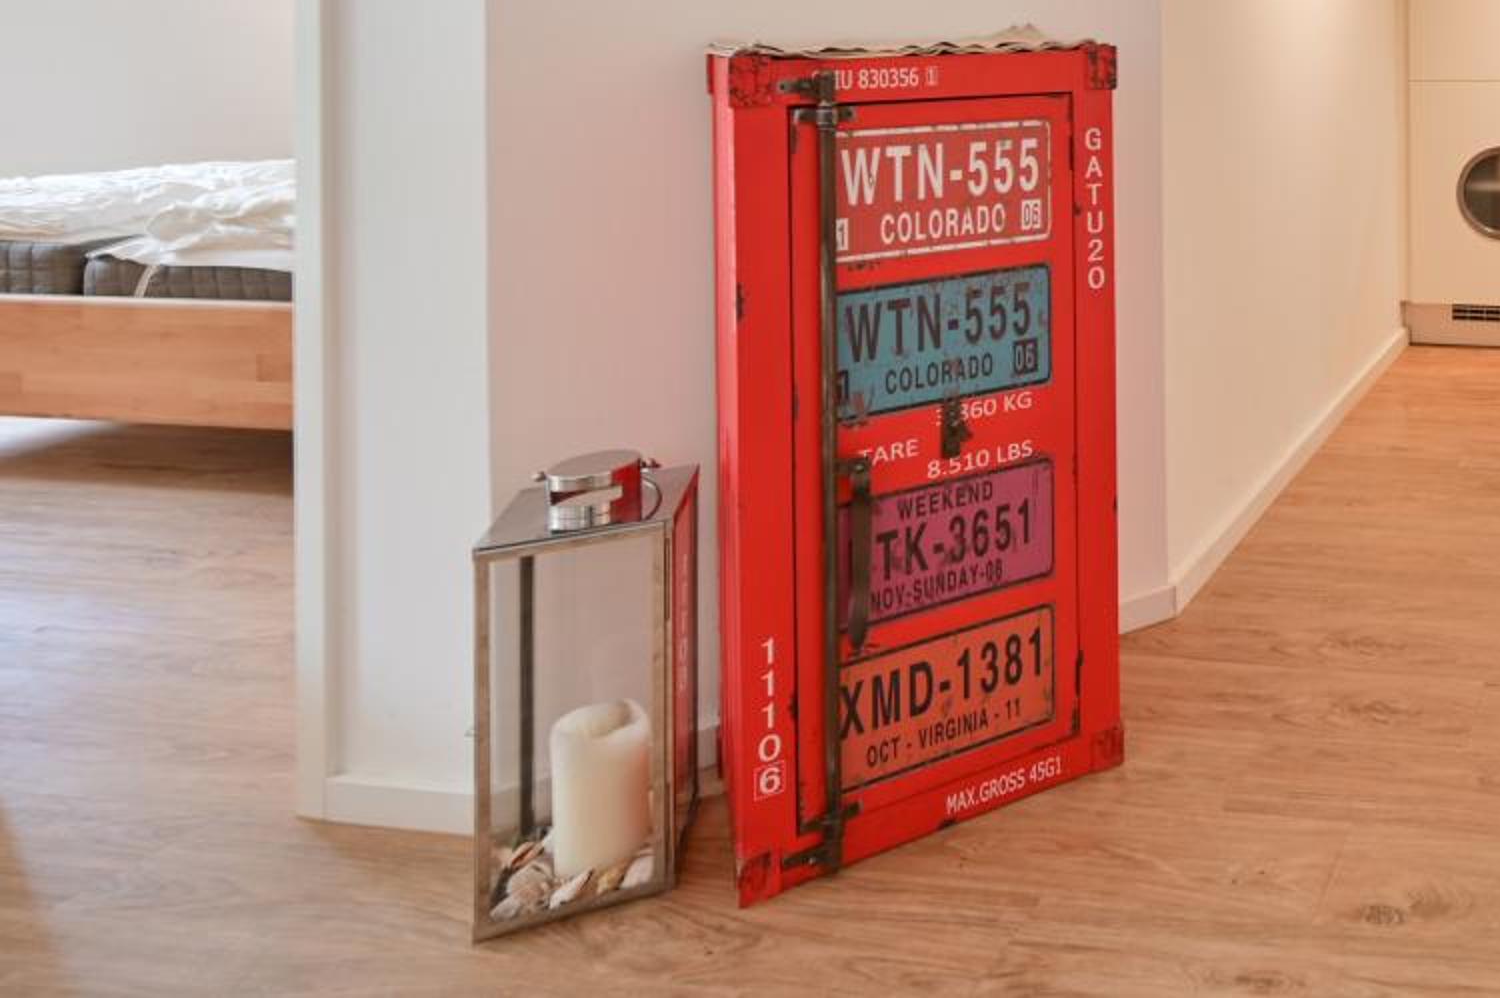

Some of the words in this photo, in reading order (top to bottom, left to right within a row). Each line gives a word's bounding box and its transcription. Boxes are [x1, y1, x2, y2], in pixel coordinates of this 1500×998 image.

[858, 67, 919, 89] 830356
[841, 138, 1039, 206] WTN-555
[880, 203, 1006, 245] COLORADO
[845, 281, 1030, 363] WTN-555
[885, 353, 993, 395] COLORADO
[1014, 340, 1036, 371] 06
[1003, 391, 1033, 412] KG
[927, 449, 989, 479] 8.510
[996, 440, 1033, 463] LBS
[898, 481, 993, 520] WEEKEND
[840, 626, 1041, 740] XMD-1381
[866, 734, 899, 768] OCT
[918, 707, 988, 749] VIRGINIA
[1006, 697, 1021, 720] 11
[946, 767, 1025, 814] MAX.GROSS
